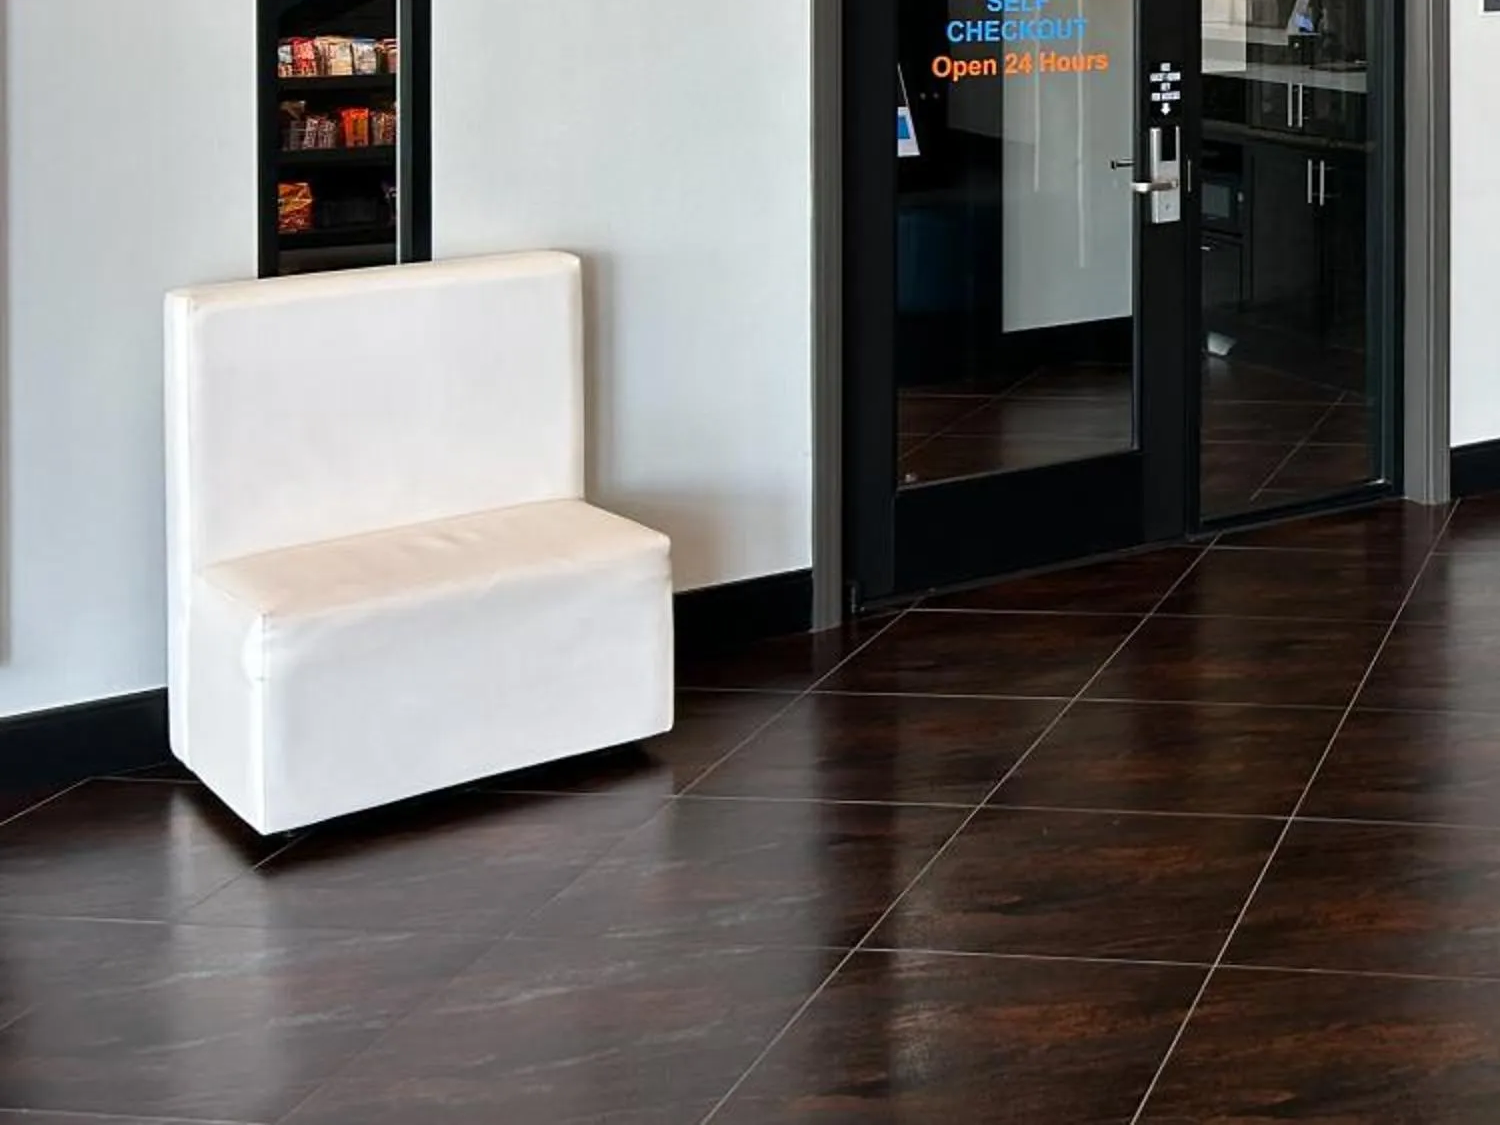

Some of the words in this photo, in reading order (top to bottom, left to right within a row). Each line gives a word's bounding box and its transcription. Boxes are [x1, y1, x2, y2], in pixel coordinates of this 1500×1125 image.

[946, 17, 1087, 43] CHECKOUT
[931, 55, 997, 82] Open
[1003, 52, 1032, 75] 24
[1038, 50, 1109, 73] Hours
